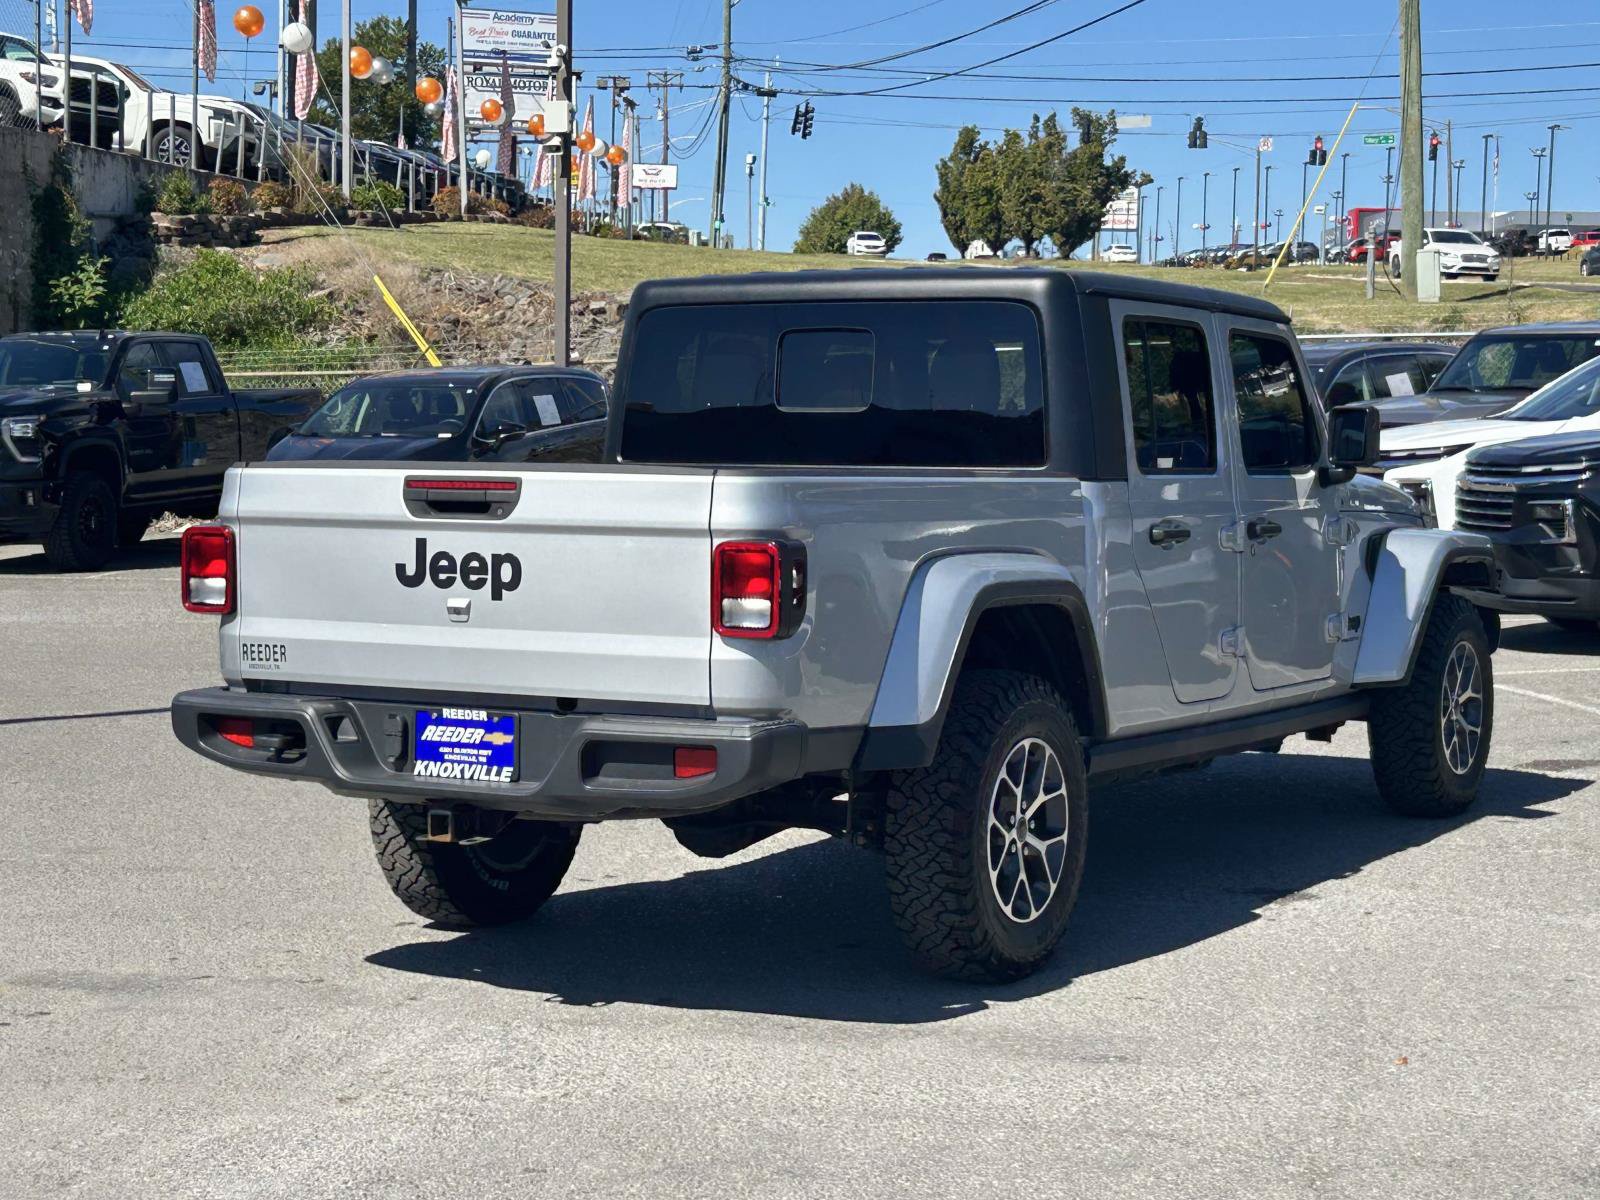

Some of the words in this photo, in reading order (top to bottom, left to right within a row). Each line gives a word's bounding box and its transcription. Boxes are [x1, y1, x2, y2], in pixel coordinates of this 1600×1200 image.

[493, 12, 536, 25] Academy
[511, 29, 556, 41] GUARANTEE
[395, 537, 523, 601] Jeep
[242, 643, 287, 663] REEDER
[442, 708, 488, 722] REEDER
[421, 725, 485, 744] REEDER
[413, 760, 514, 783] KNOXVILLE
